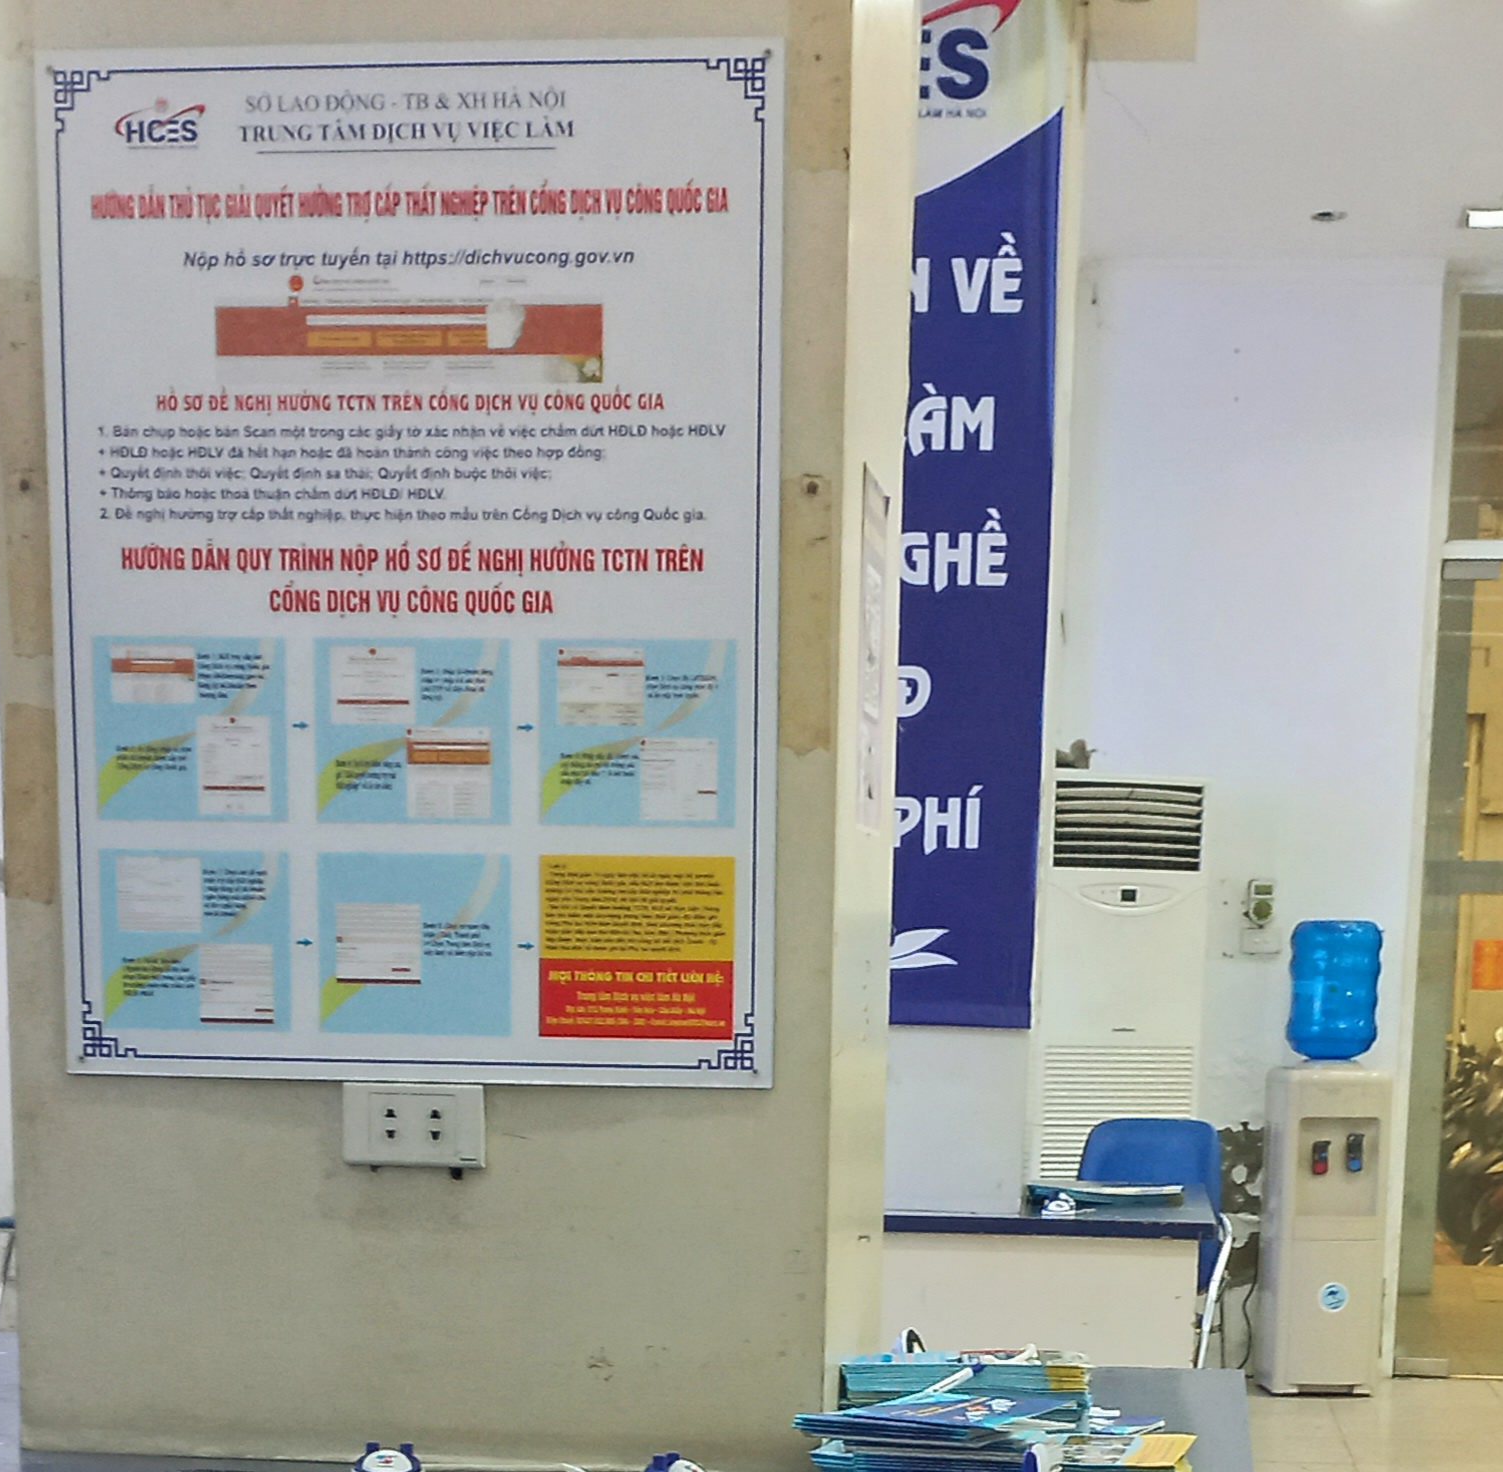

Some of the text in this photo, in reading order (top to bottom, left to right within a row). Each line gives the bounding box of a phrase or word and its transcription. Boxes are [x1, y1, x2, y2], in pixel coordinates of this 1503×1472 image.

[245, 91, 271, 113] SỞ
[278, 94, 319, 112] LAO
[326, 90, 385, 114] ĐỘNG
[404, 93, 428, 110] TB
[435, 93, 449, 110] &
[457, 92, 486, 109] XH
[493, 87, 521, 109] HÀ
[529, 88, 566, 110] NỘI
[125, 119, 198, 143] HCES
[241, 115, 574, 145] TRUNG TÂM DỊCH VỤ VIỆC LÀM
[184, 247, 635, 270] Nộp hồ sơ trực tuyến tại https://dichvucong.gov.vn
[951, 232, 1023, 313] VỀ
[156, 385, 665, 416] HỒ SƠ ĐỀ NGHỊ HƯỞNG TCTN TRÊN CỔNG DỊCH VỤ CÔNG QUỐC GIA
[191, 539, 230, 571] DẪN
[237, 548, 272, 573] QUY
[279, 543, 334, 571] TRÌNH
[341, 544, 379, 576] NỘP
[416, 546, 441, 571] SƠ
[478, 549, 524, 577] NGHỊ
[530, 541, 595, 571] HƯỞNG
[601, 549, 649, 571] TCTN
[655, 543, 704, 571] TRÊN
[269, 580, 554, 618] CỔNG DỊCH VỤ CÔNG QUỐC GIA
[894, 785, 983, 855] PHÍ
